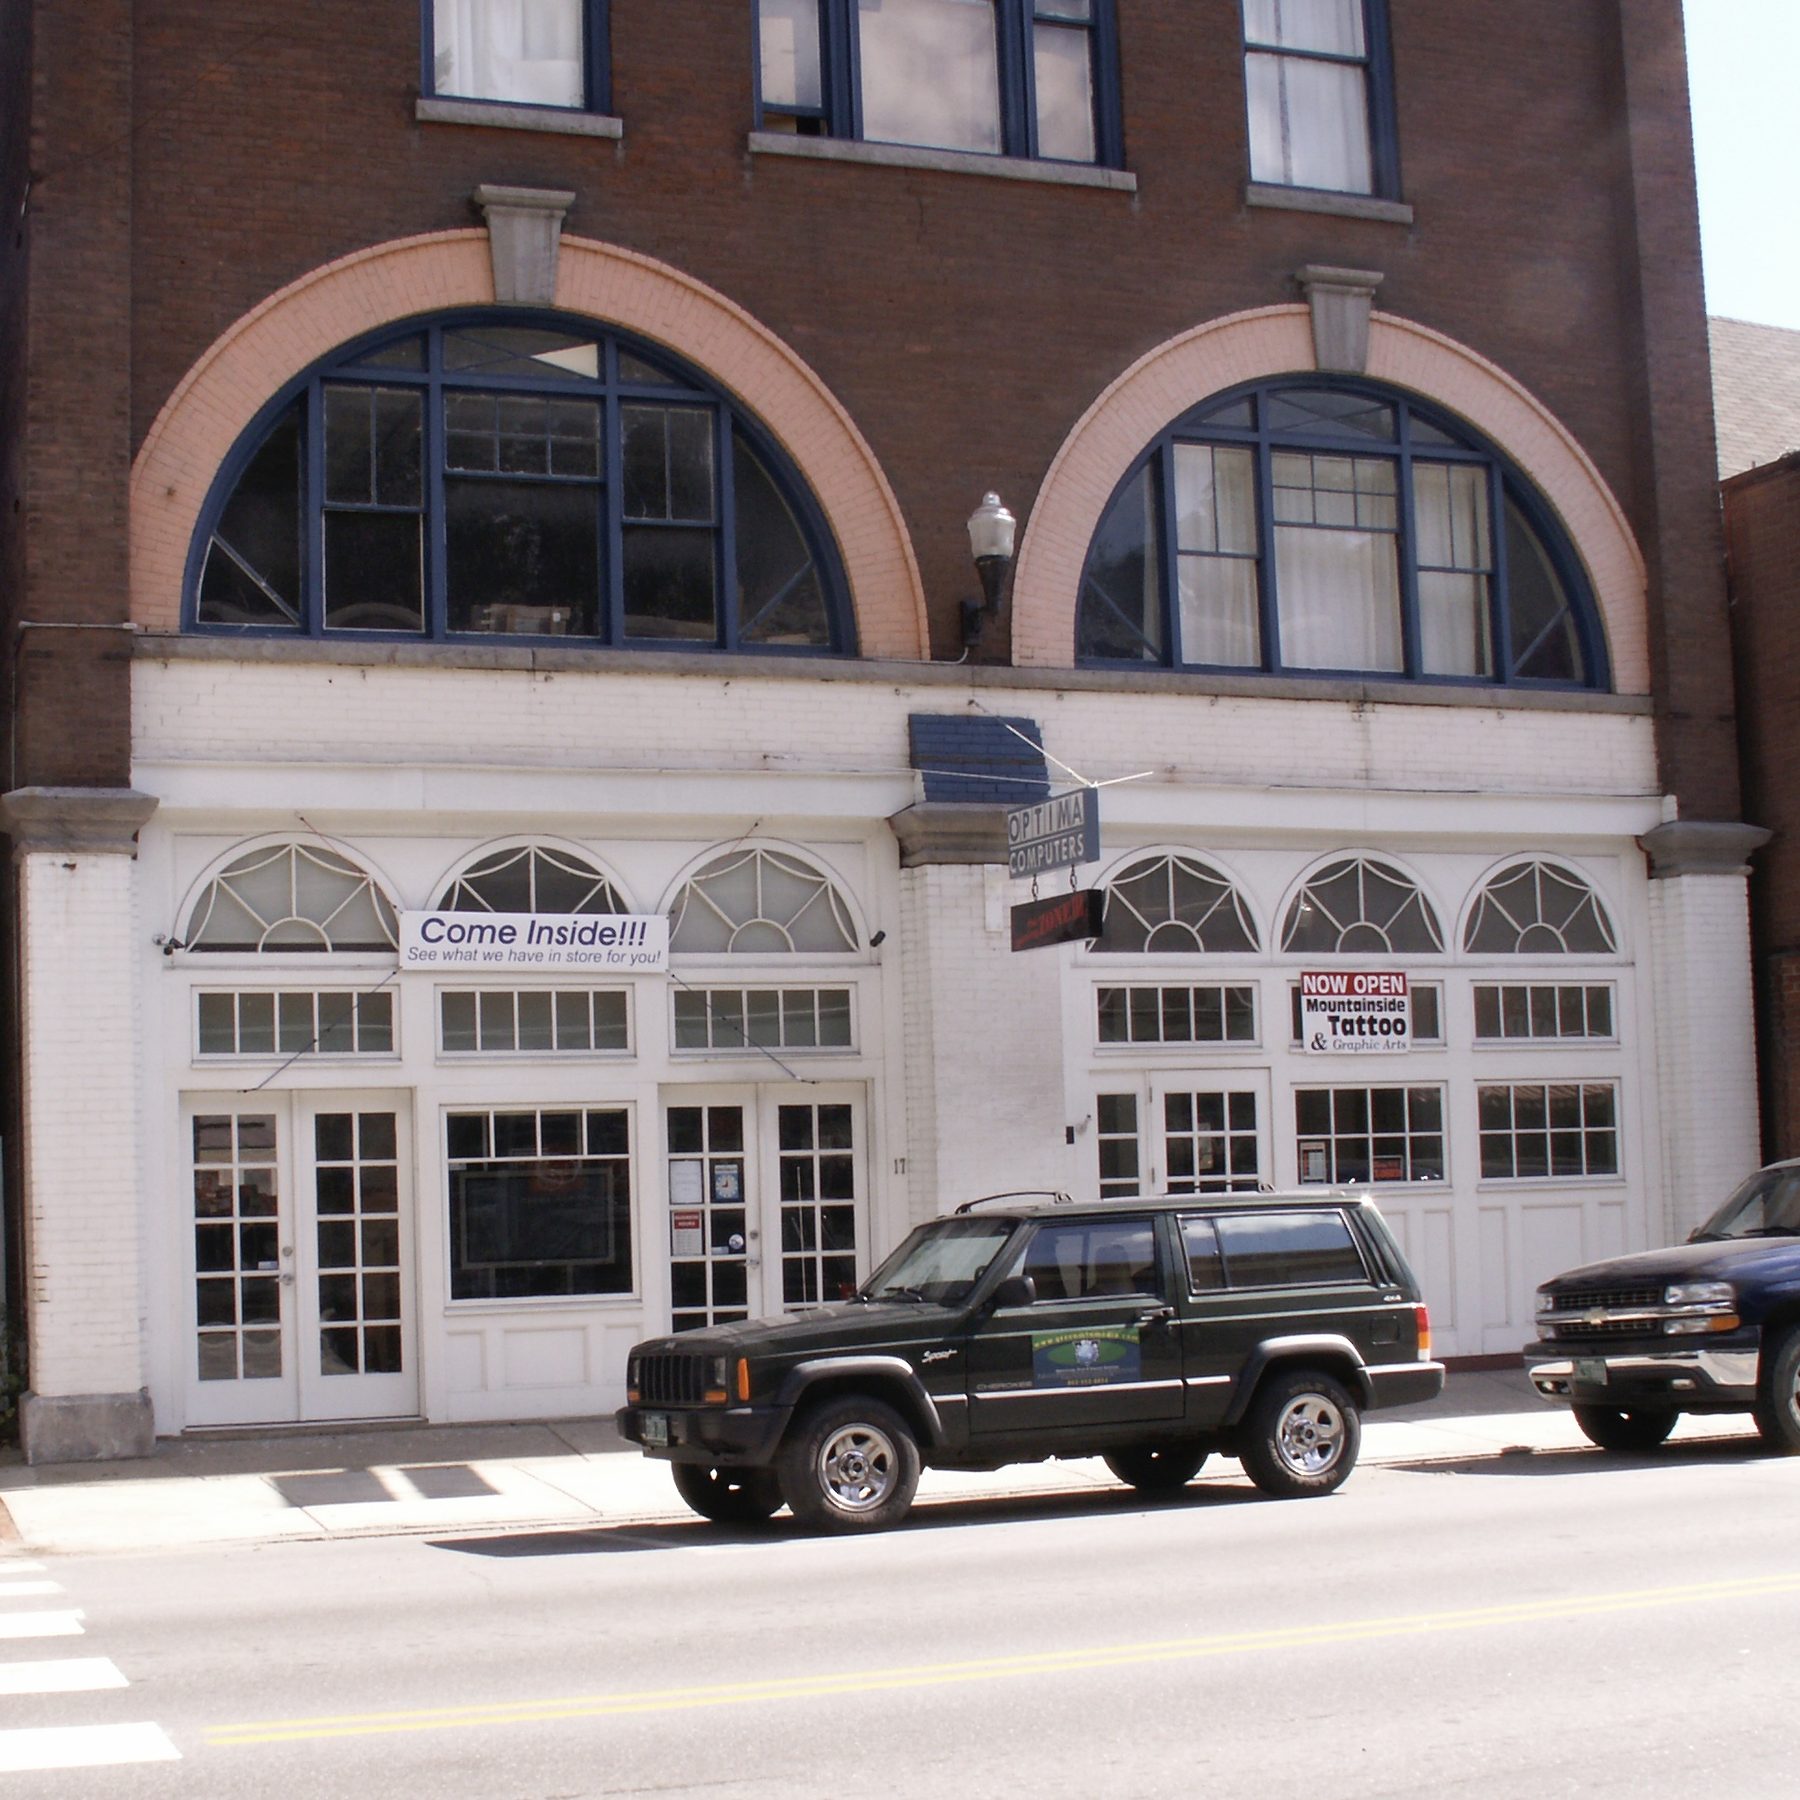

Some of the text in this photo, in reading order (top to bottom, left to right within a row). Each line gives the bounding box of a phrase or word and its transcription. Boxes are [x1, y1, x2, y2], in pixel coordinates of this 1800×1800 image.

[1009, 795, 1083, 841] OPTIMA
[1009, 834, 1085, 874] COMPUTERS
[420, 917, 647, 946] Come Inside!!!
[407, 947, 661, 966] See what we have in store for you!
[1303, 975, 1404, 994] NOW OPEN
[1306, 998, 1405, 1012] Mountainside
[1327, 1015, 1406, 1036] Tattoo
[1310, 1031, 1407, 1052] & Graphic Arts
[894, 1158, 906, 1174] 17
